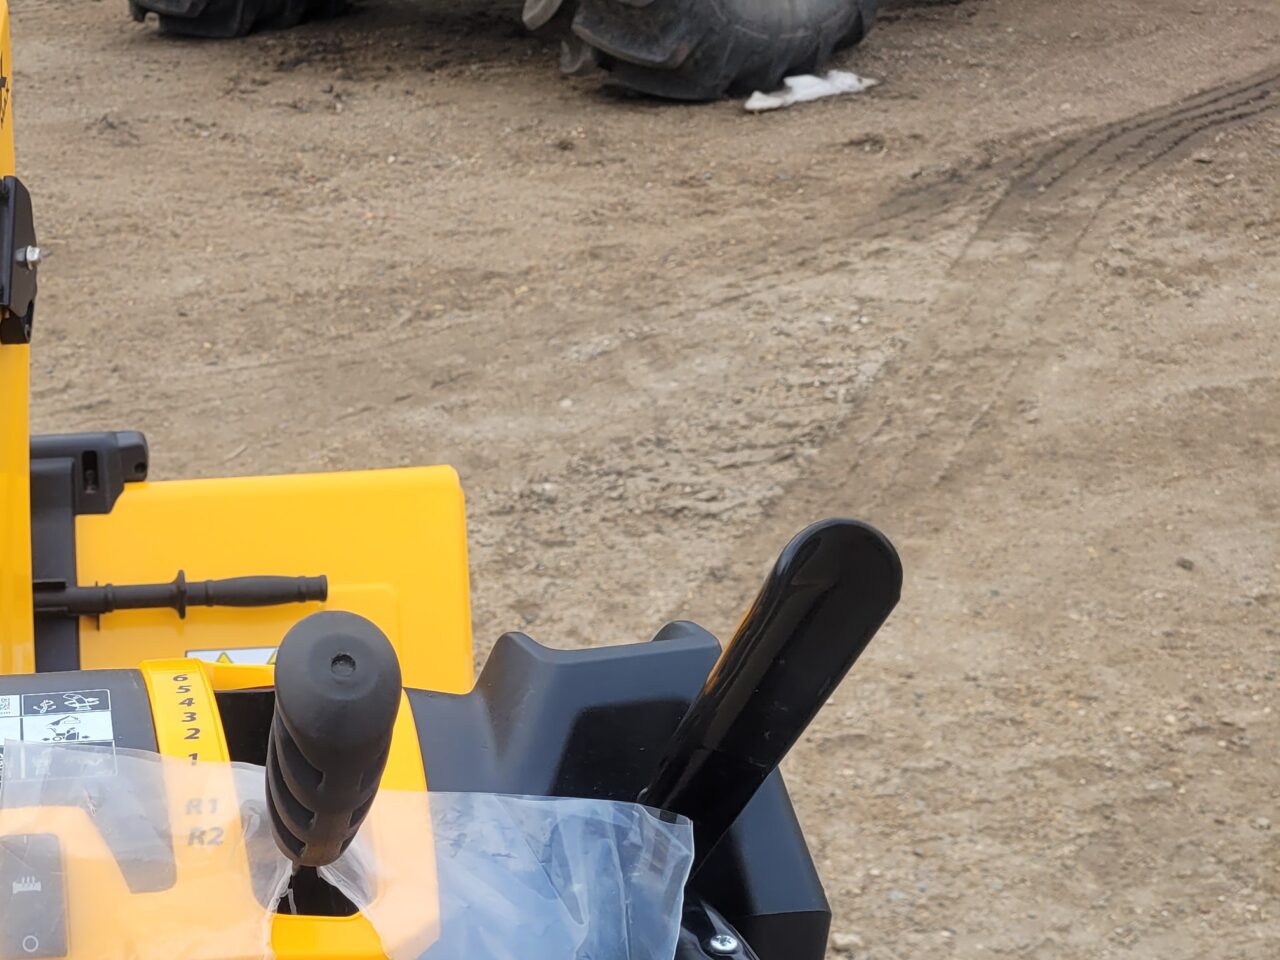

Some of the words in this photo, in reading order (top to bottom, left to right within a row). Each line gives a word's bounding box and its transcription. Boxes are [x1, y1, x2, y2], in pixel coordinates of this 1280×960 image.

[173, 674, 188, 682] 6
[176, 685, 192, 694] 5
[179, 698, 195, 708] 4
[182, 712, 197, 722] 3
[184, 728, 200, 740] 2
[189, 753, 198, 766] 1
[186, 799, 218, 815] R1
[188, 828, 224, 846] R2
